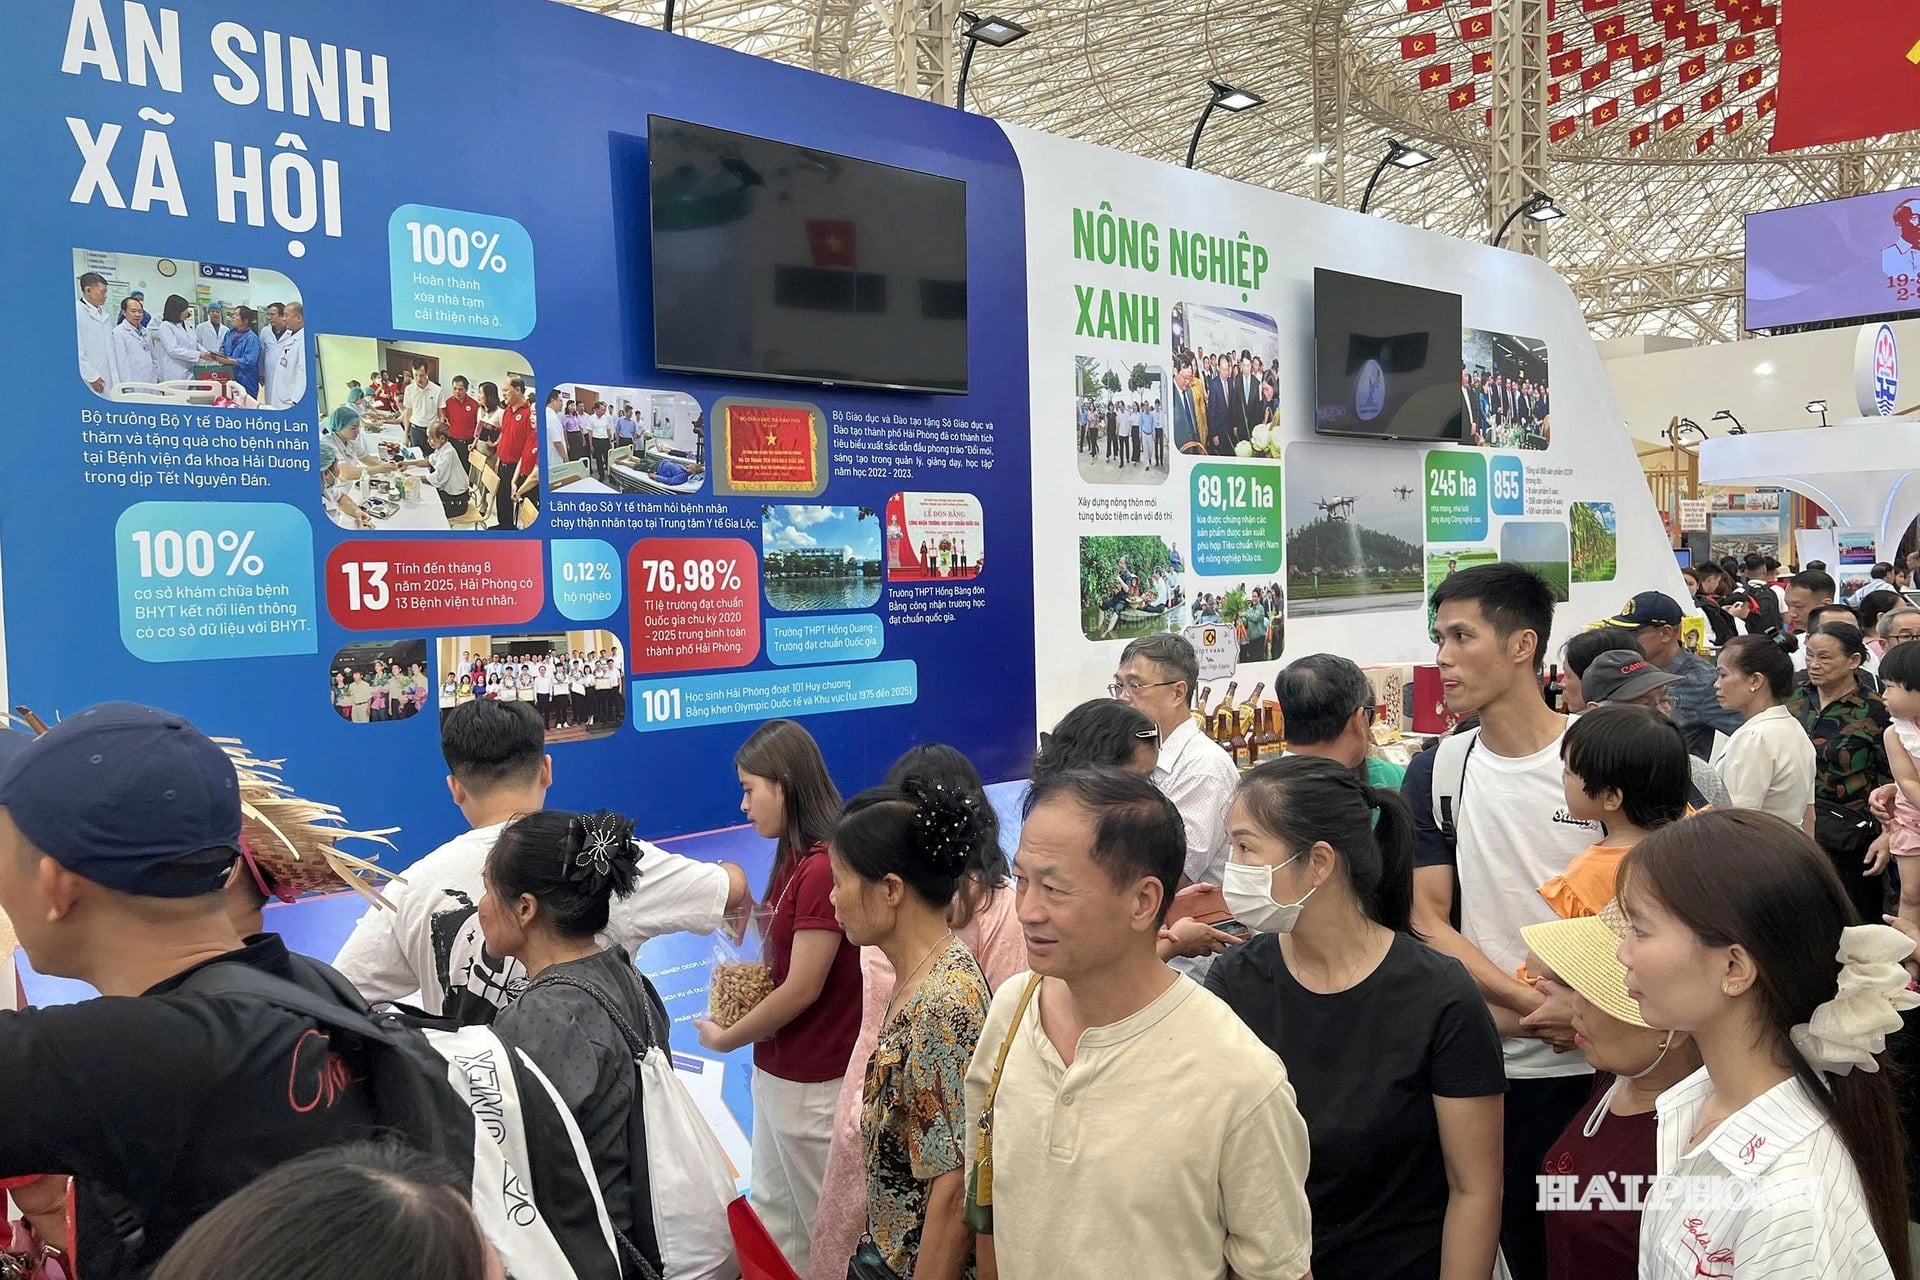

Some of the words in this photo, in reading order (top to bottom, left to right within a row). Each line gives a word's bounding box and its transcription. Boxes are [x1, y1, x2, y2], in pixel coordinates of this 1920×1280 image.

[61, 0, 182, 93] AN
[210, 21, 390, 131] SINH
[65, 107, 188, 217] XÃ
[214, 132, 341, 257] HỘI
[406, 222, 507, 273] 100%
[1072, 200, 1159, 272] NÔNG
[1169, 227, 1269, 303] NGHIỆP
[413, 272, 444, 286] Hoàn
[447, 277, 480, 291] thành
[438, 293, 459, 306] nhà
[462, 295, 484, 309] tạm
[435, 310, 465, 325] thiện
[469, 313, 489, 325] nhà
[1074, 284, 1160, 345] XANH
[81, 410, 102, 426] Bộ
[106, 411, 157, 429] trưởng
[160, 413, 180, 429] Bộ
[183, 414, 192, 427] Y
[196, 414, 211, 428] tế
[215, 416, 241, 429] Đào
[246, 416, 281, 434] Hồng
[284, 419, 308, 432] Lan
[82, 430, 122, 443] thăm
[126, 432, 143, 445] và
[146, 432, 179, 449] tặng
[183, 434, 209, 449] quà
[212, 435, 237, 448] cho
[240, 436, 274, 452] bệnh
[277, 438, 309, 451] nhân
[83, 450, 103, 466] tại
[108, 450, 147, 467] Bệnh
[150, 452, 181, 468] viện
[184, 453, 202, 466] đa
[205, 453, 239, 467] khoa
[243, 454, 264, 468] Hải
[268, 455, 310, 472] Dương
[84, 470, 126, 487] trong
[130, 471, 153, 487] dịp
[156, 470, 180, 485] Tết
[183, 472, 237, 488] Nguyên
[241, 473, 271, 486] Đán.
[1430, 468, 1457, 497] 245
[1460, 470, 1477, 497] ha
[1493, 469, 1519, 500] 855
[1198, 474, 1247, 512] 89,12
[1251, 476, 1274, 508] ha
[550, 501, 576, 512] Lãnh
[579, 501, 597, 514] đạo
[599, 500, 613, 512] Sở
[615, 502, 622, 512] Y
[624, 501, 635, 512] tế
[637, 502, 662, 513] thăm
[664, 502, 678, 513] hỏi
[680, 503, 704, 515] bệnh
[705, 504, 728, 514] nhân
[550, 518, 574, 530] chạy
[577, 517, 599, 530] thận
[601, 517, 625, 528] nhân
[627, 518, 643, 530] tạo
[645, 518, 657, 530] tại
[659, 518, 686, 530] Trung
[687, 518, 705, 528] tâm
[706, 518, 713, 528] Y
[714, 517, 724, 528] tế
[725, 518, 739, 529] Gia
[740, 518, 759, 531] Lộc.
[132, 530, 265, 578] 100%
[394, 562, 421, 575] Tính
[423, 561, 446, 574] đến
[448, 562, 482, 576] tháng
[484, 561, 491, 573] 8
[562, 562, 612, 583] 0,12%
[642, 559, 741, 594] 76,98%
[134, 588, 152, 600] cơ
[156, 585, 173, 599] sở
[176, 584, 216, 599] khám
[219, 584, 253, 598] chữa
[256, 584, 289, 599] bệnh
[341, 561, 390, 611] 13
[394, 580, 422, 592] năm
[424, 579, 457, 592] 2025,
[460, 577, 479, 590] Hải
[481, 578, 517, 591] Phòng
[520, 578, 533, 589] có
[395, 597, 408, 609] 13
[411, 596, 442, 612] Bệnh
[444, 596, 469, 610] viện
[471, 596, 484, 607] tư
[486, 594, 517, 606] nhân.
[564, 591, 578, 604] hộ
[579, 590, 612, 603] nghèo
[655, 600, 664, 612] lệ
[666, 600, 698, 611] trường
[699, 599, 715, 610] đạt
[716, 596, 743, 608] chuẩn
[135, 605, 176, 620] BHYT
[180, 604, 202, 617] kết
[206, 603, 227, 617] nối
[231, 603, 255, 616] liên
[258, 602, 297, 616] thông
[645, 614, 669, 627] Quốc
[671, 615, 686, 627] gia
[687, 614, 705, 624] chu
[706, 613, 717, 626] kỳ
[718, 612, 742, 623] 2020
[136, 626, 154, 639] có
[158, 626, 176, 638] cơ
[179, 623, 196, 637] sở
[199, 623, 218, 636] dữ
[220, 622, 245, 637] liệu
[247, 621, 267, 633] với
[270, 619, 311, 633] BHYT.
[652, 630, 676, 641] 2025
[678, 629, 703, 640] trung
[705, 628, 724, 638] bình
[727, 627, 746, 637] toàn
[646, 646, 674, 656] thành
[676, 644, 693, 656] phố
[695, 643, 710, 654] Hải
[712, 642, 743, 653] Phòng.
[685, 691, 704, 704] Học
[705, 689, 725, 701] sinh
[726, 687, 741, 699] Hải
[743, 686, 770, 699] Phòng
[792, 683, 803, 693] 101
[805, 682, 821, 694] Huy
[642, 687, 681, 723] 101
